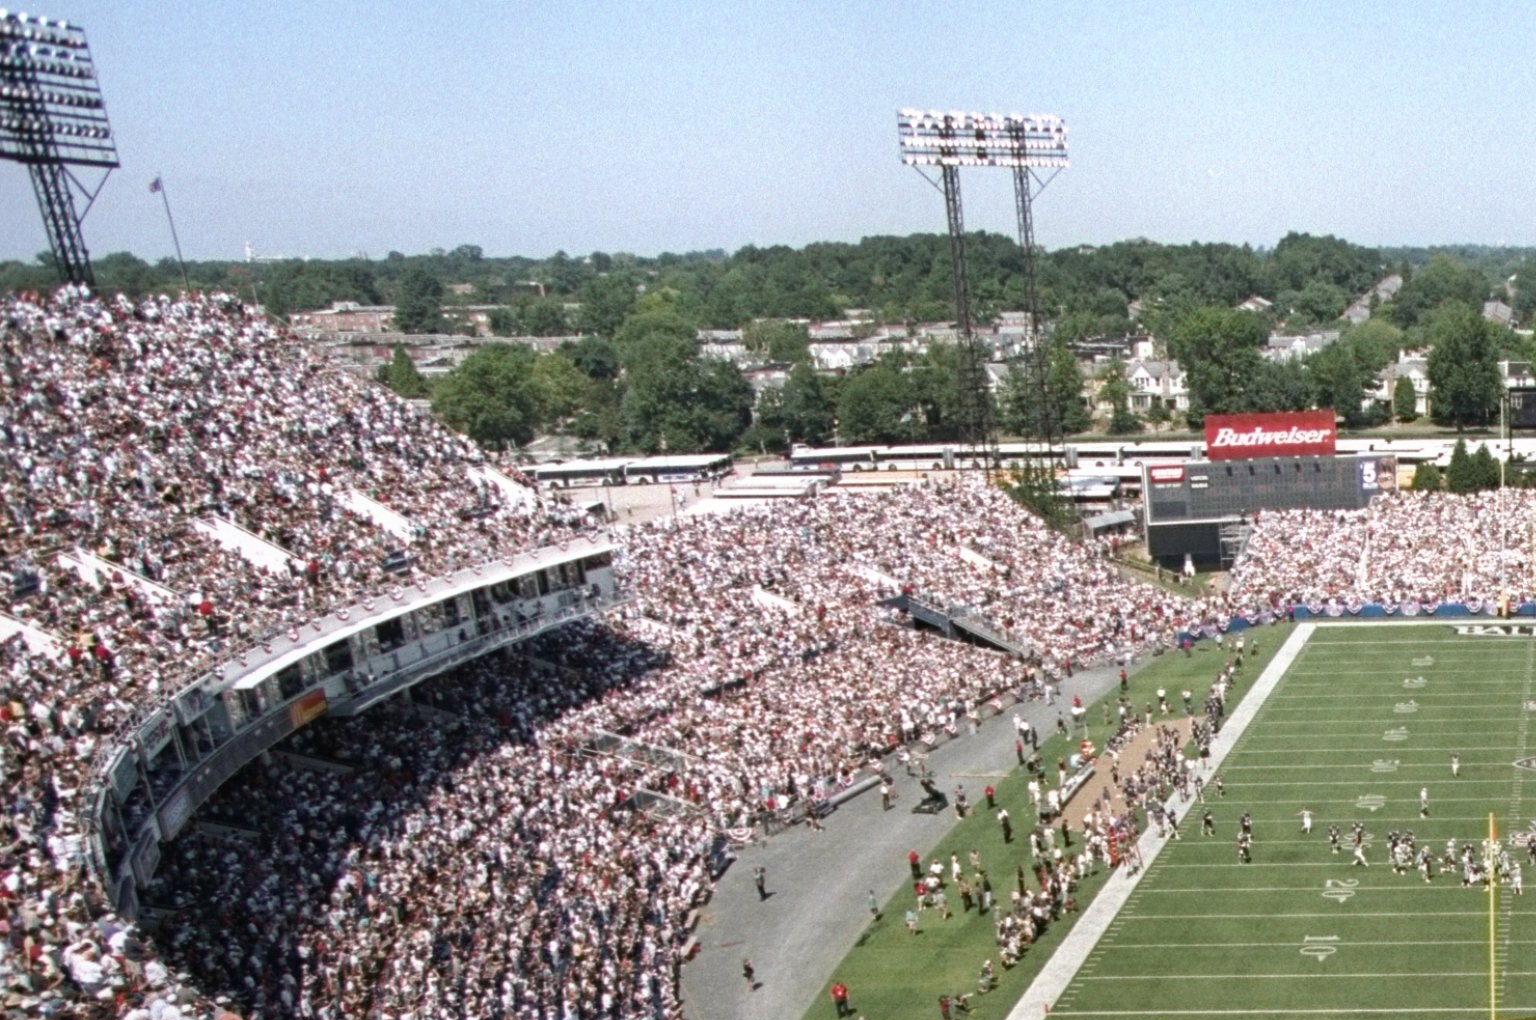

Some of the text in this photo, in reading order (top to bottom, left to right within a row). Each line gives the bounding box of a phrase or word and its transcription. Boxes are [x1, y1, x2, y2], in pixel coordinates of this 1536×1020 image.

[1211, 426, 1331, 447] Budweiser
[1321, 879, 1360, 898] 20
[1300, 935, 1340, 955] 10
